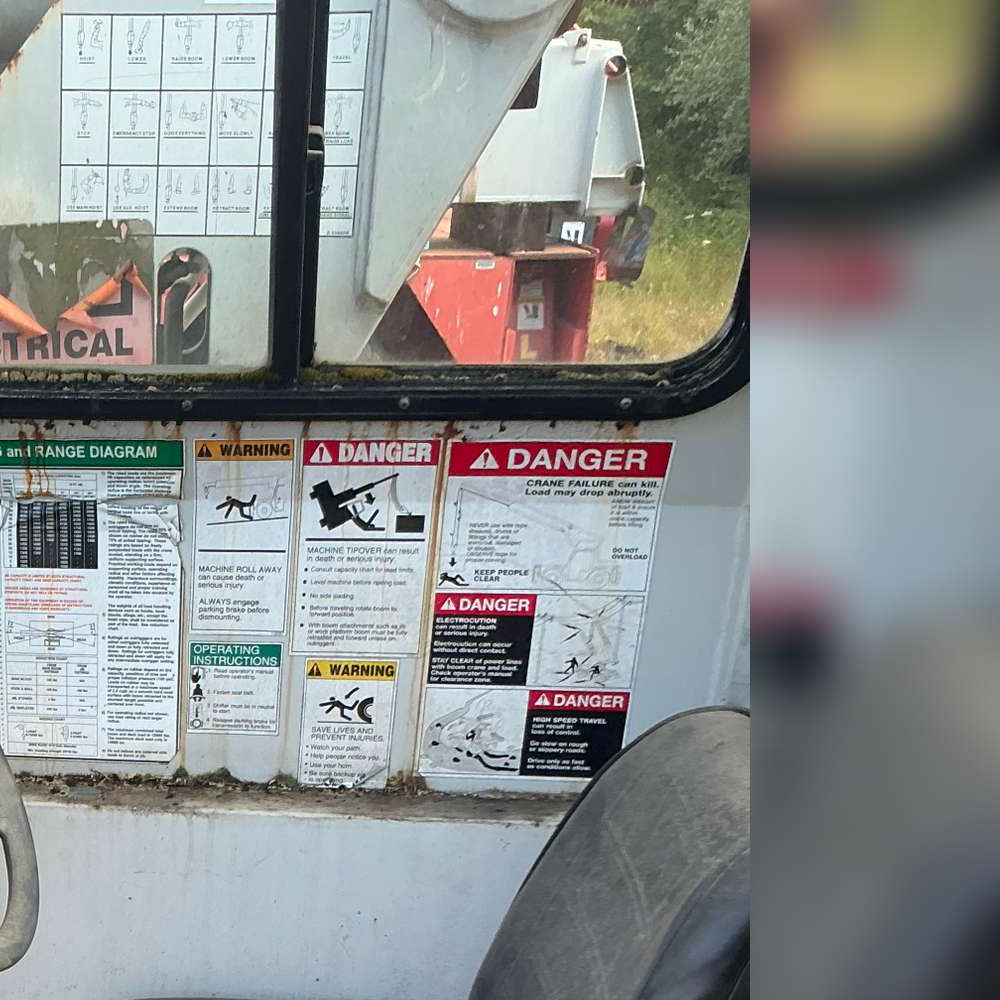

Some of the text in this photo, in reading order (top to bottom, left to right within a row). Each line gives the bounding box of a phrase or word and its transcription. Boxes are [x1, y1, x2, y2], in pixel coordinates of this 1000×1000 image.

[7, 445, 31, 458] and
[34, 445, 86, 459] RANGE
[89, 445, 158, 459] DIAGRAM
[219, 443, 291, 457] WARNING
[338, 442, 432, 463] DANGER
[506, 448, 649, 471] DANGER
[526, 479, 565, 488] CRANE
[568, 479, 614, 488] FAILURE
[640, 480, 659, 489] kill.
[525, 488, 654, 498] Load may drop abruptly.
[307, 547, 344, 555] MACHINE
[346, 547, 382, 555] TIPOVER
[399, 547, 419, 555] result
[198, 566, 283, 574] MACHINE ROLL AWAY
[235, 574, 256, 582] death
[199, 598, 260, 608] ALWAYS engage
[459, 598, 530, 612] DANGER
[198, 606, 225, 615] parking
[225, 606, 246, 614] brake
[193, 644, 260, 655] OPERATING
[193, 656, 278, 667] INSTRUCTIONS
[329, 663, 395, 677] WARNING
[553, 693, 625, 708] DANGER
[311, 726, 374, 735] SAVE LIVES AND
[311, 734, 346, 742] PREVENT
[310, 752, 325, 760] Help
[325, 753, 347, 761] people
